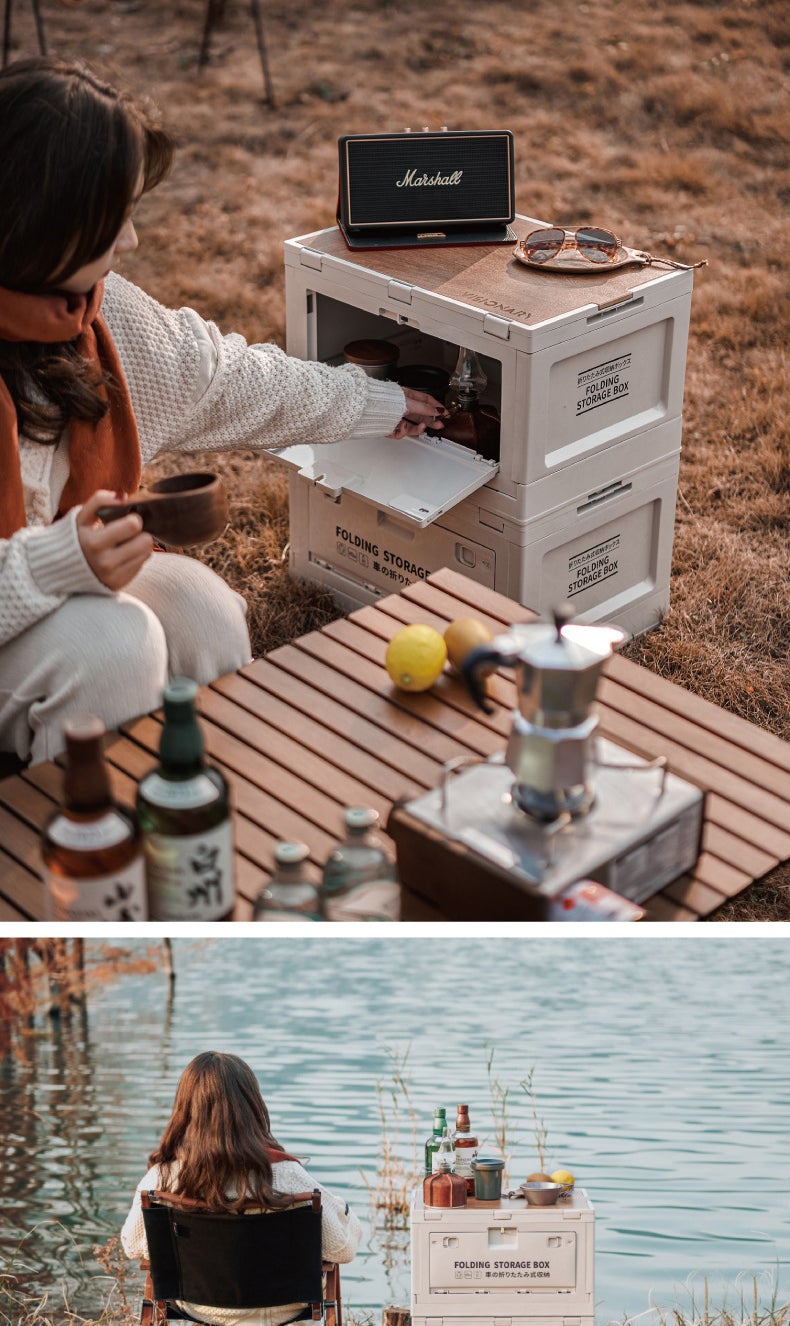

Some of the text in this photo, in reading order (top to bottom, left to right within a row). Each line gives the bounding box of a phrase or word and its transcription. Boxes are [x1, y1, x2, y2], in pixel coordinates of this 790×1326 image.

[396, 168, 463, 187] Marshall
[576, 381, 630, 411] STORAGE BOX
[585, 374, 620, 396] FOLDING
[336, 525, 380, 557] FOLDING
[568, 559, 619, 593] STORAGE BOX
[576, 555, 610, 579] FOLDING
[454, 1261, 550, 1269] FOLDING STORAGE BOX
